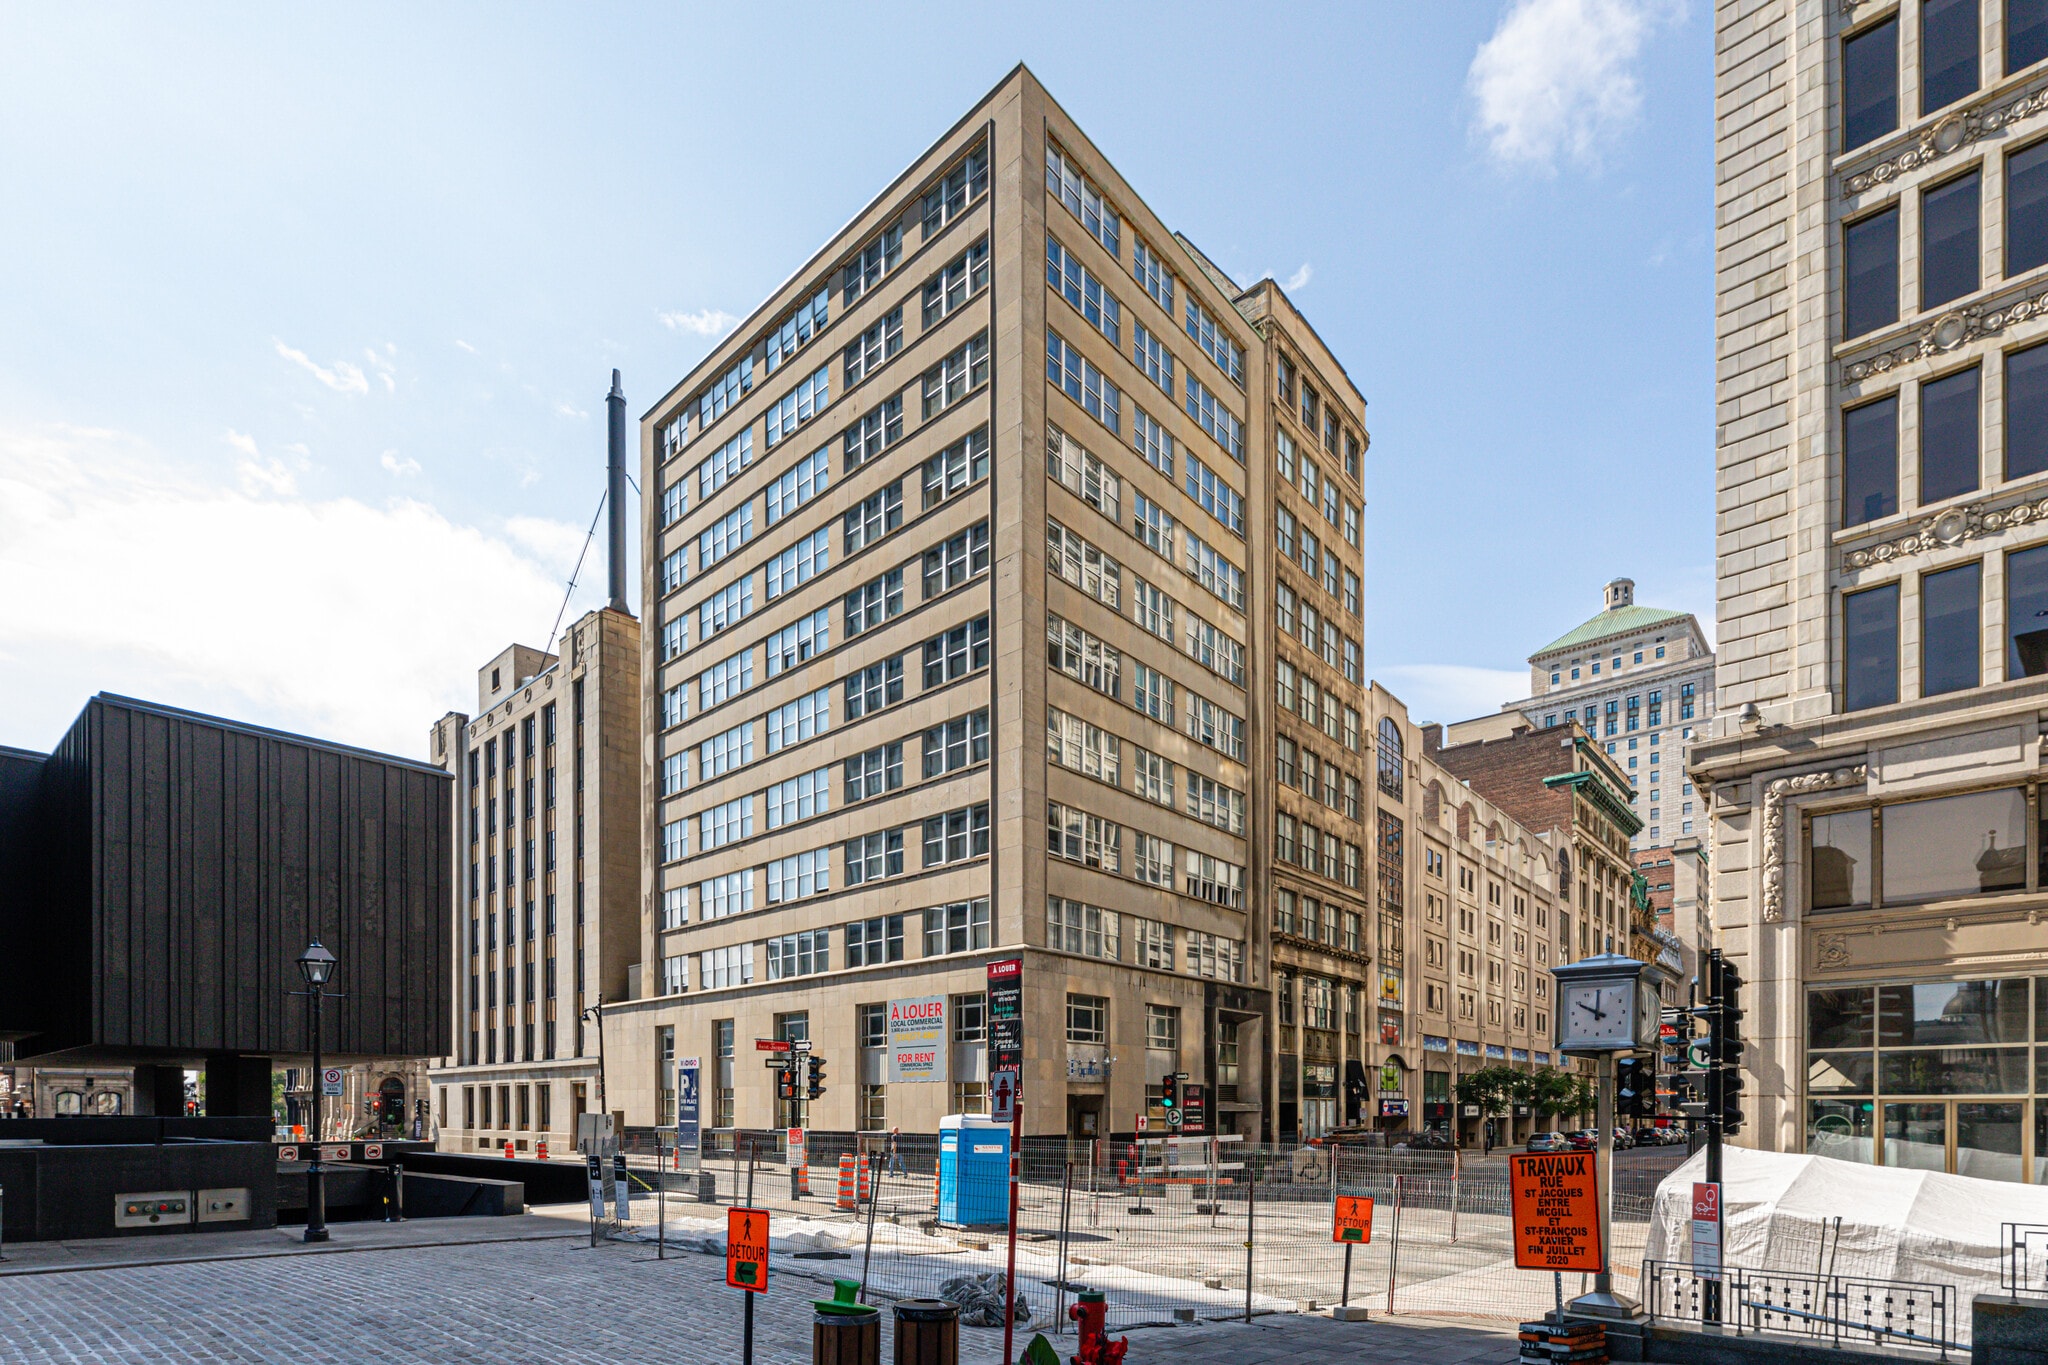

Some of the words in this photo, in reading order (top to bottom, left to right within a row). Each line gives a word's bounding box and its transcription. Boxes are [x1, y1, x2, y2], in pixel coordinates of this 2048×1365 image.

[992, 964, 998, 974] À
[998, 964, 1016, 973] LOUER
[891, 1002, 900, 1021] À
[903, 1002, 943, 1019] LOUER
[891, 1019, 906, 1028] LOCAL
[907, 1017, 943, 1026] COMMERCIAL
[897, 1053, 913, 1063] FOR
[914, 1051, 936, 1062] RENT
[680, 1074, 691, 1096] P
[1518, 1156, 1586, 1177] TRAVAUX
[1540, 1176, 1563, 1188] RUE
[1524, 1189, 1536, 1198] ST
[1538, 1188, 1583, 1197] JACQUES
[1538, 1198, 1570, 1207] ENTRE
[1536, 1208, 1572, 1217] MCGILL
[1337, 1215, 1370, 1228] DÉTOUR
[1549, 1217, 1560, 1226] ET
[1525, 1226, 1588, 1238] ST-FRANÇOIS
[1539, 1236, 1574, 1245] XAVIER
[730, 1241, 765, 1262] DÉTOUR
[1528, 1245, 1543, 1254] FIN
[1546, 1246, 1586, 1256] JUILLET
[1546, 1255, 1568, 1265] 2020
